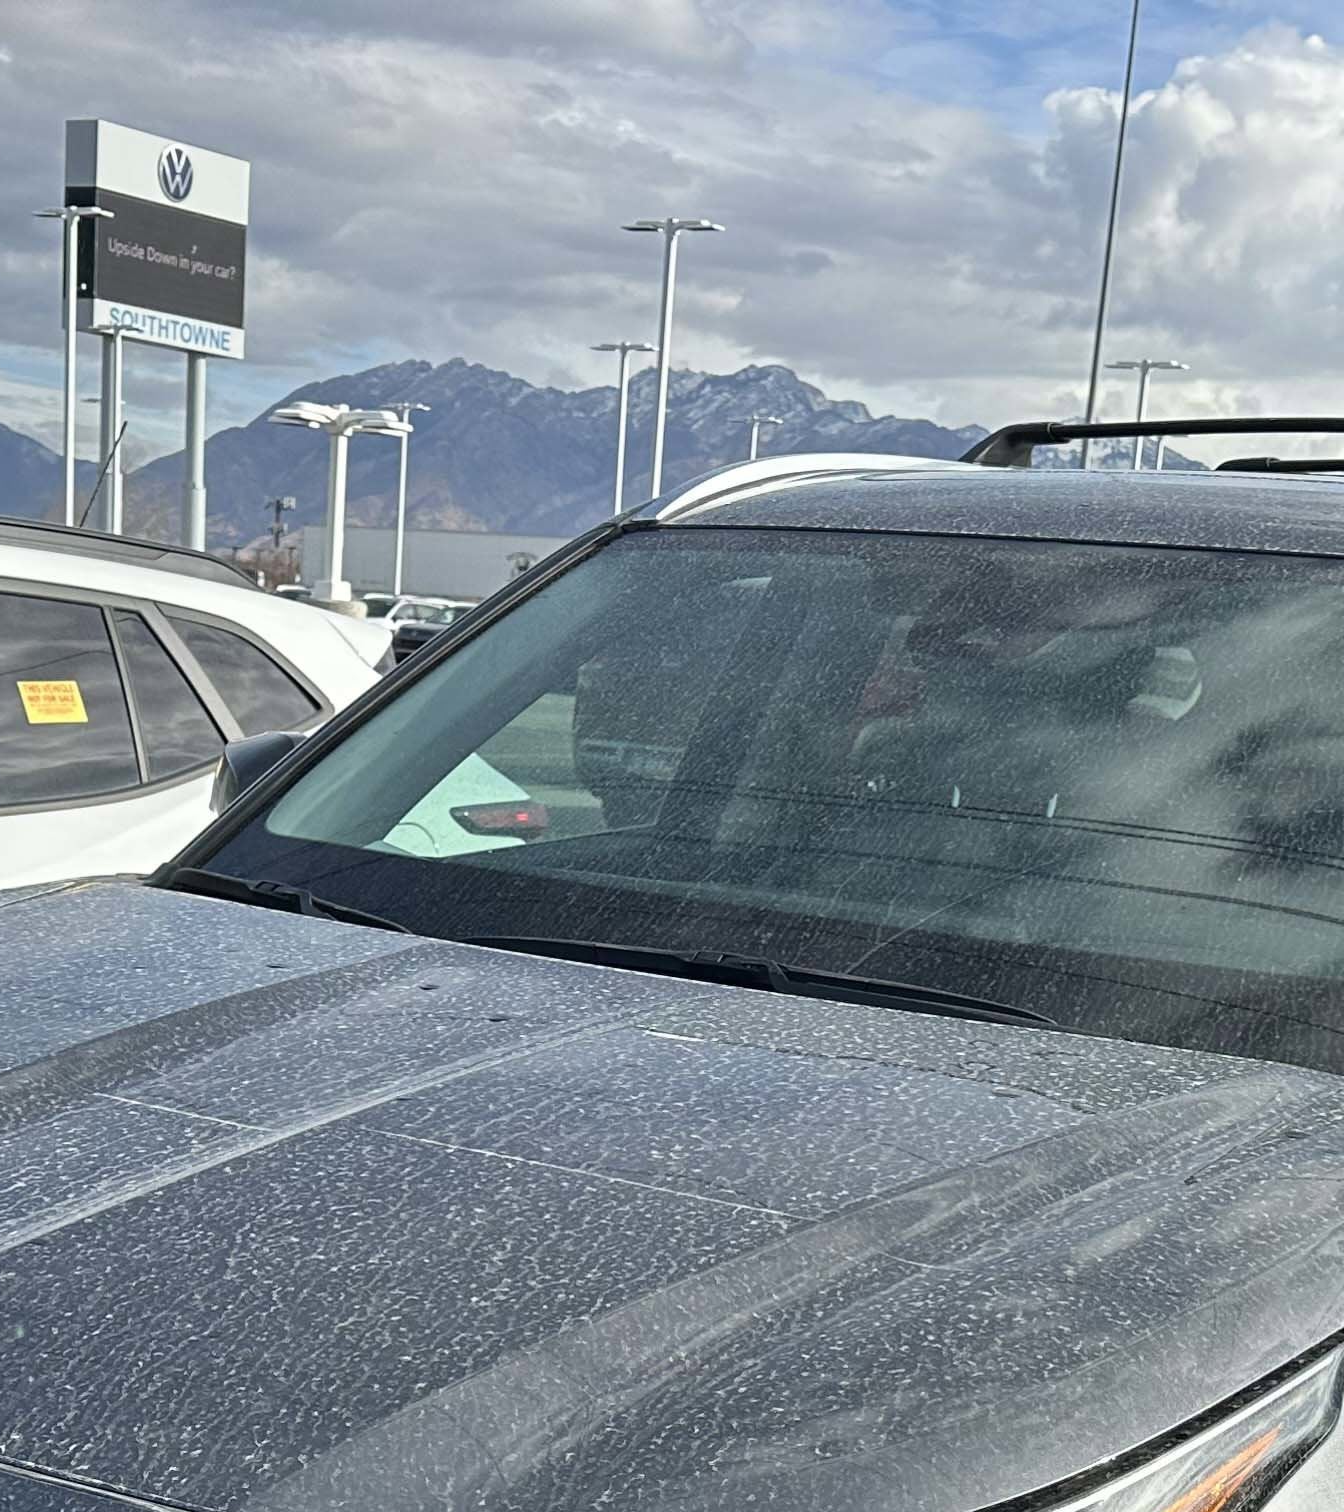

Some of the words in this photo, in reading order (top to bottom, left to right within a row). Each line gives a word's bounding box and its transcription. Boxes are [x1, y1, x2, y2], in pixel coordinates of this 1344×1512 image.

[108, 237, 145, 260] Upside
[146, 246, 178, 267] Down
[178, 254, 191, 270] in
[190, 260, 214, 275] your
[214, 266, 237, 280] car?
[109, 306, 231, 352] SOUTHTOWNE
